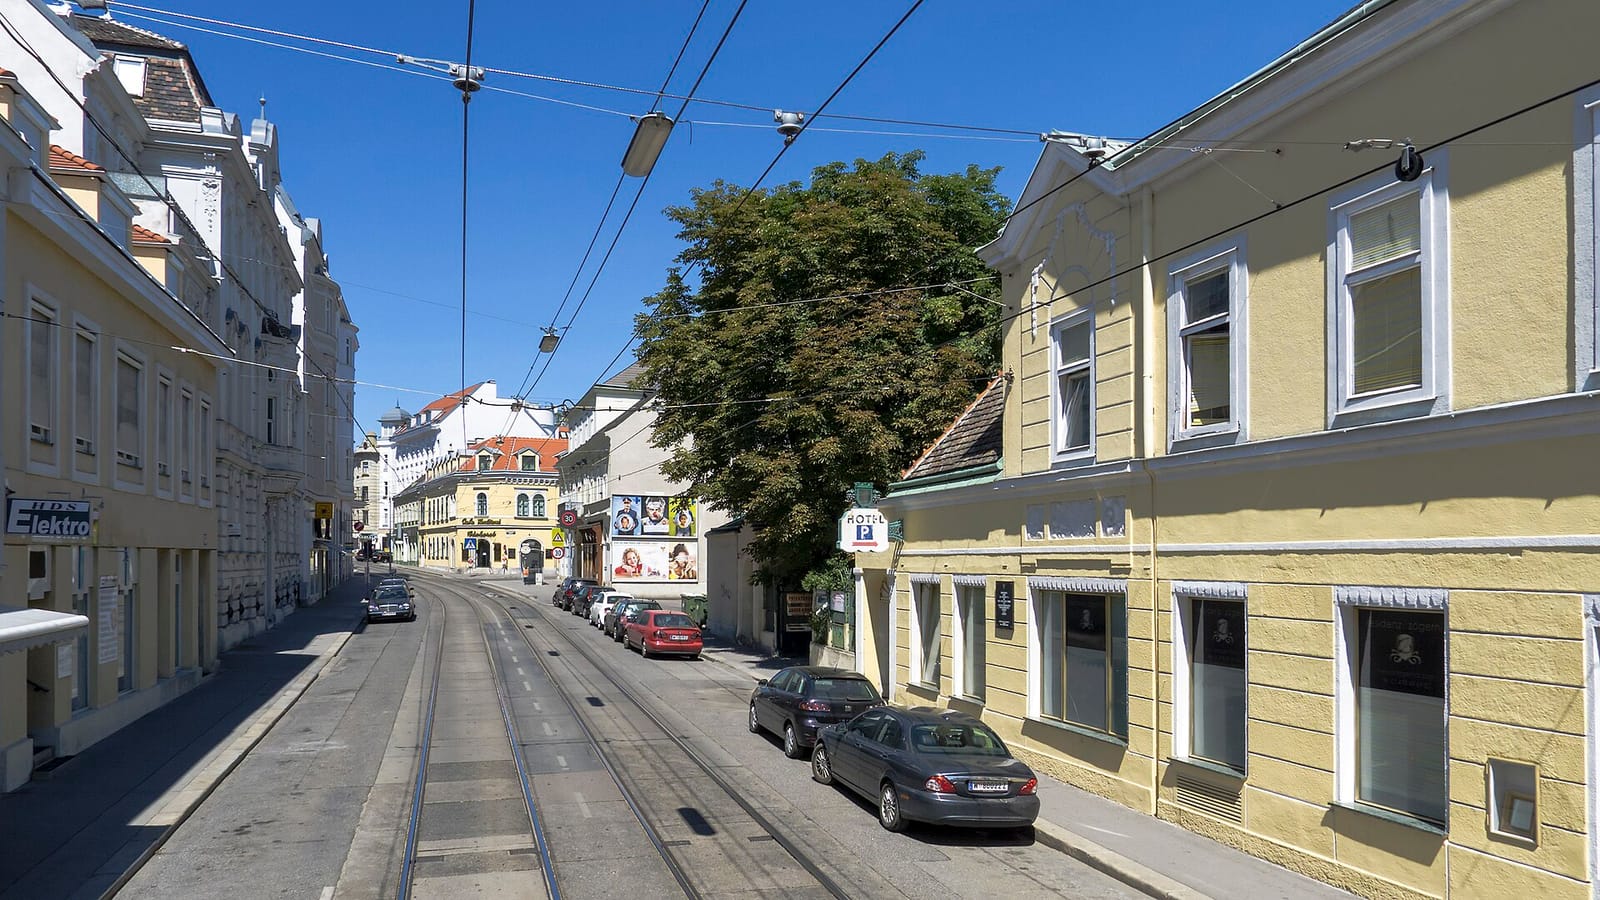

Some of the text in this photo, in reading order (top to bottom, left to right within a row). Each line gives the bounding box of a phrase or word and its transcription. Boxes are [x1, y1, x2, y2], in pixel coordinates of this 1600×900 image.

[32, 502, 77, 511] HDS
[7, 500, 90, 536] Elektro
[847, 514, 885, 524] HOTEL
[860, 525, 870, 540] P
